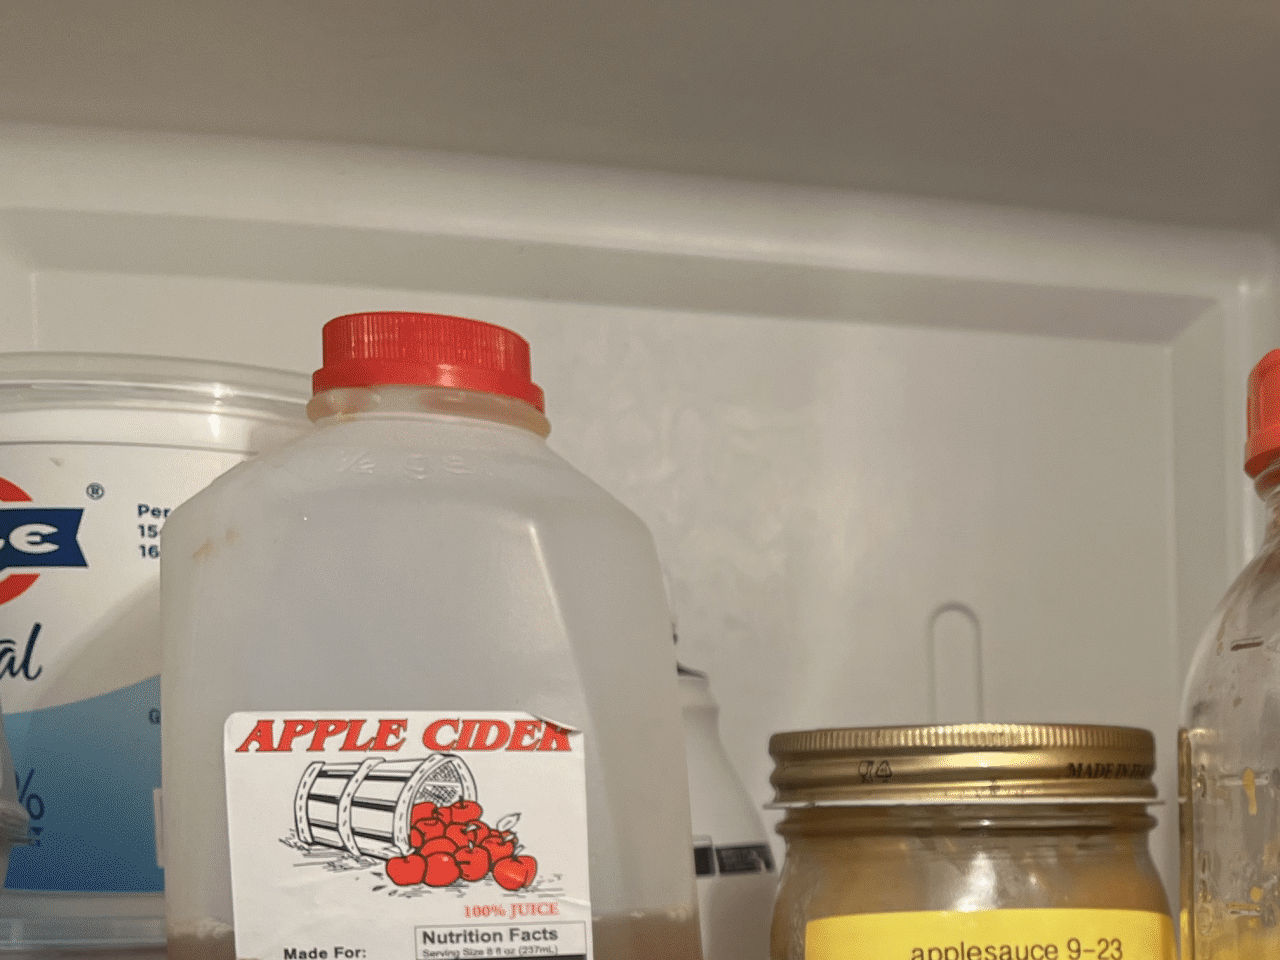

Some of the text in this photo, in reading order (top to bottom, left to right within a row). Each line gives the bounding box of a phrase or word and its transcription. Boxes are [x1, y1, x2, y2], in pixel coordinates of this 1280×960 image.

[137, 504, 172, 518] Per
[235, 718, 573, 753] APPLE CIDER
[463, 901, 559, 919] 100% JUICE
[422, 926, 559, 946] Nutrition Facts
[283, 946, 367, 960] Made For:
[422, 948, 460, 960] Serving
[462, 947, 484, 957] Size
